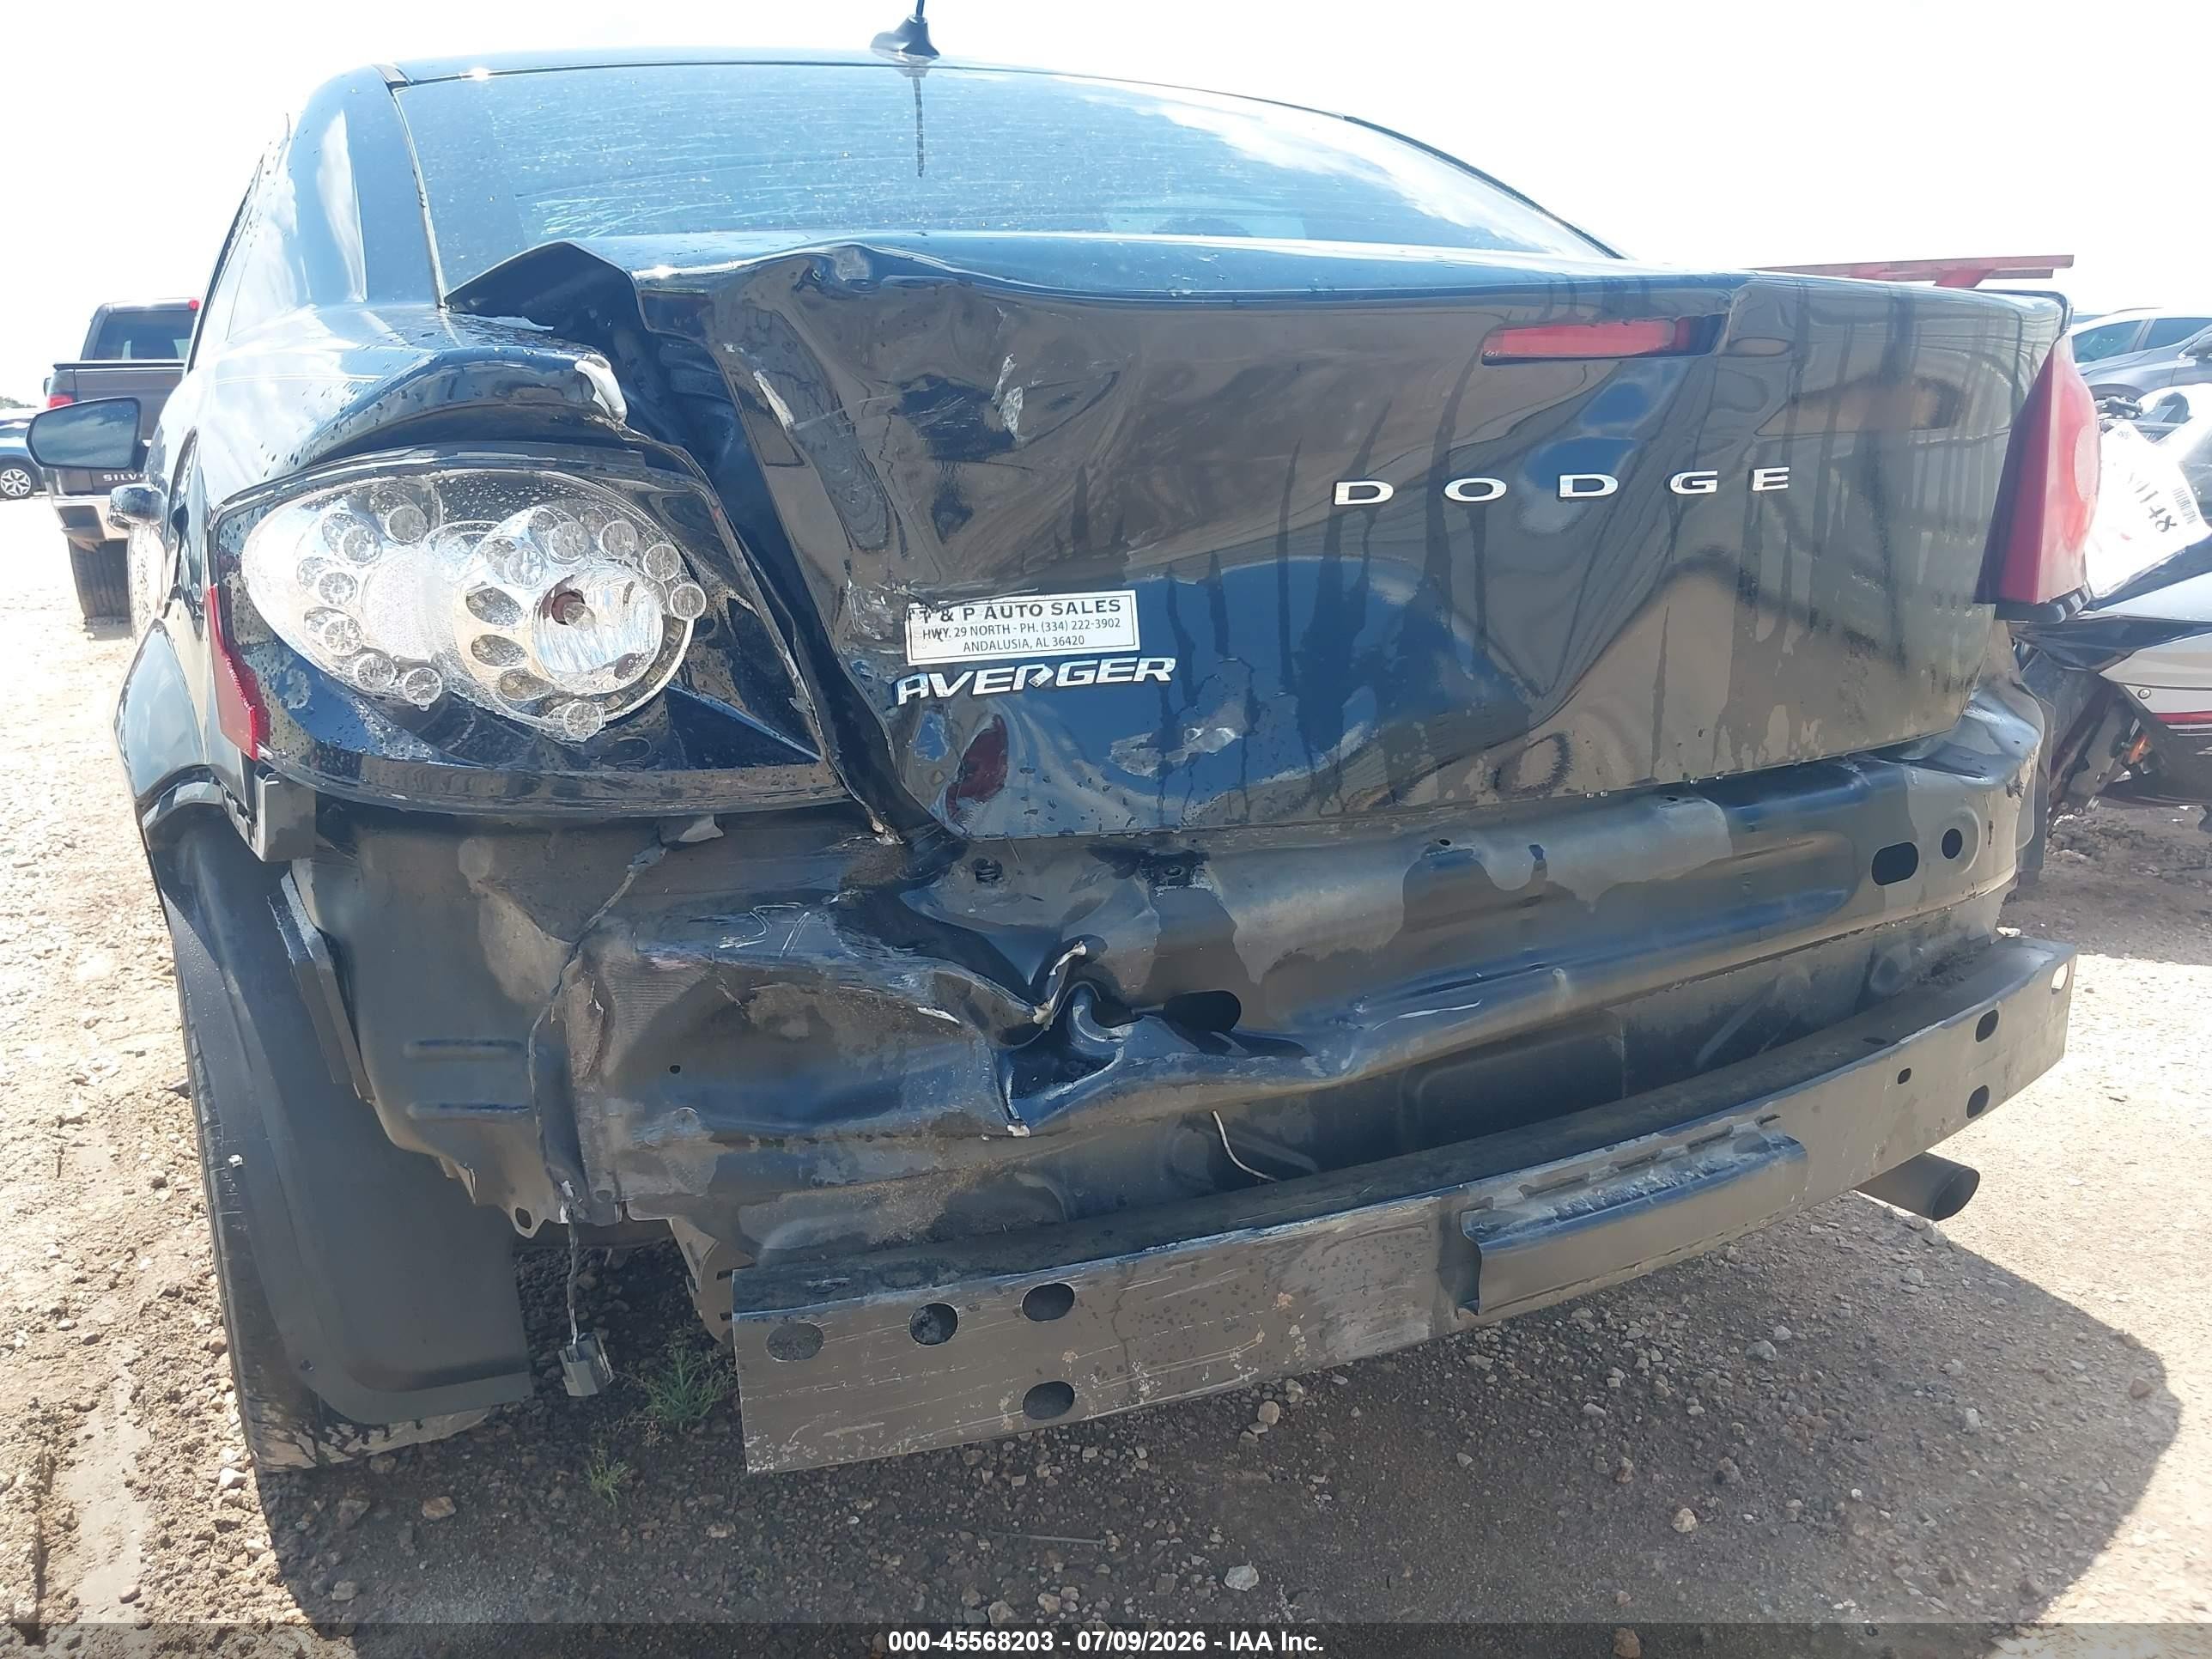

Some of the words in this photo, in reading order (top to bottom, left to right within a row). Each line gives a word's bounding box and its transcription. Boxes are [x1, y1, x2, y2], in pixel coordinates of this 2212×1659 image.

[1334, 466, 1790, 505] DODGE
[940, 608, 954, 622] &
[963, 607, 975, 621] P
[984, 602, 1043, 620] AUTO
[1050, 599, 1121, 617] SALES
[922, 628, 951, 641] HWY.
[954, 627, 967, 637] 29
[970, 623, 1011, 635] NORTH
[1020, 622, 1039, 634] PH.
[1041, 621, 1068, 633] (334)
[1071, 617, 1121, 631] 222-3902
[963, 639, 1033, 653] ANDALUSIA,
[1036, 638, 1049, 648] AL
[1051, 635, 1085, 647] 36420
[896, 657, 1176, 706] AVENGER
